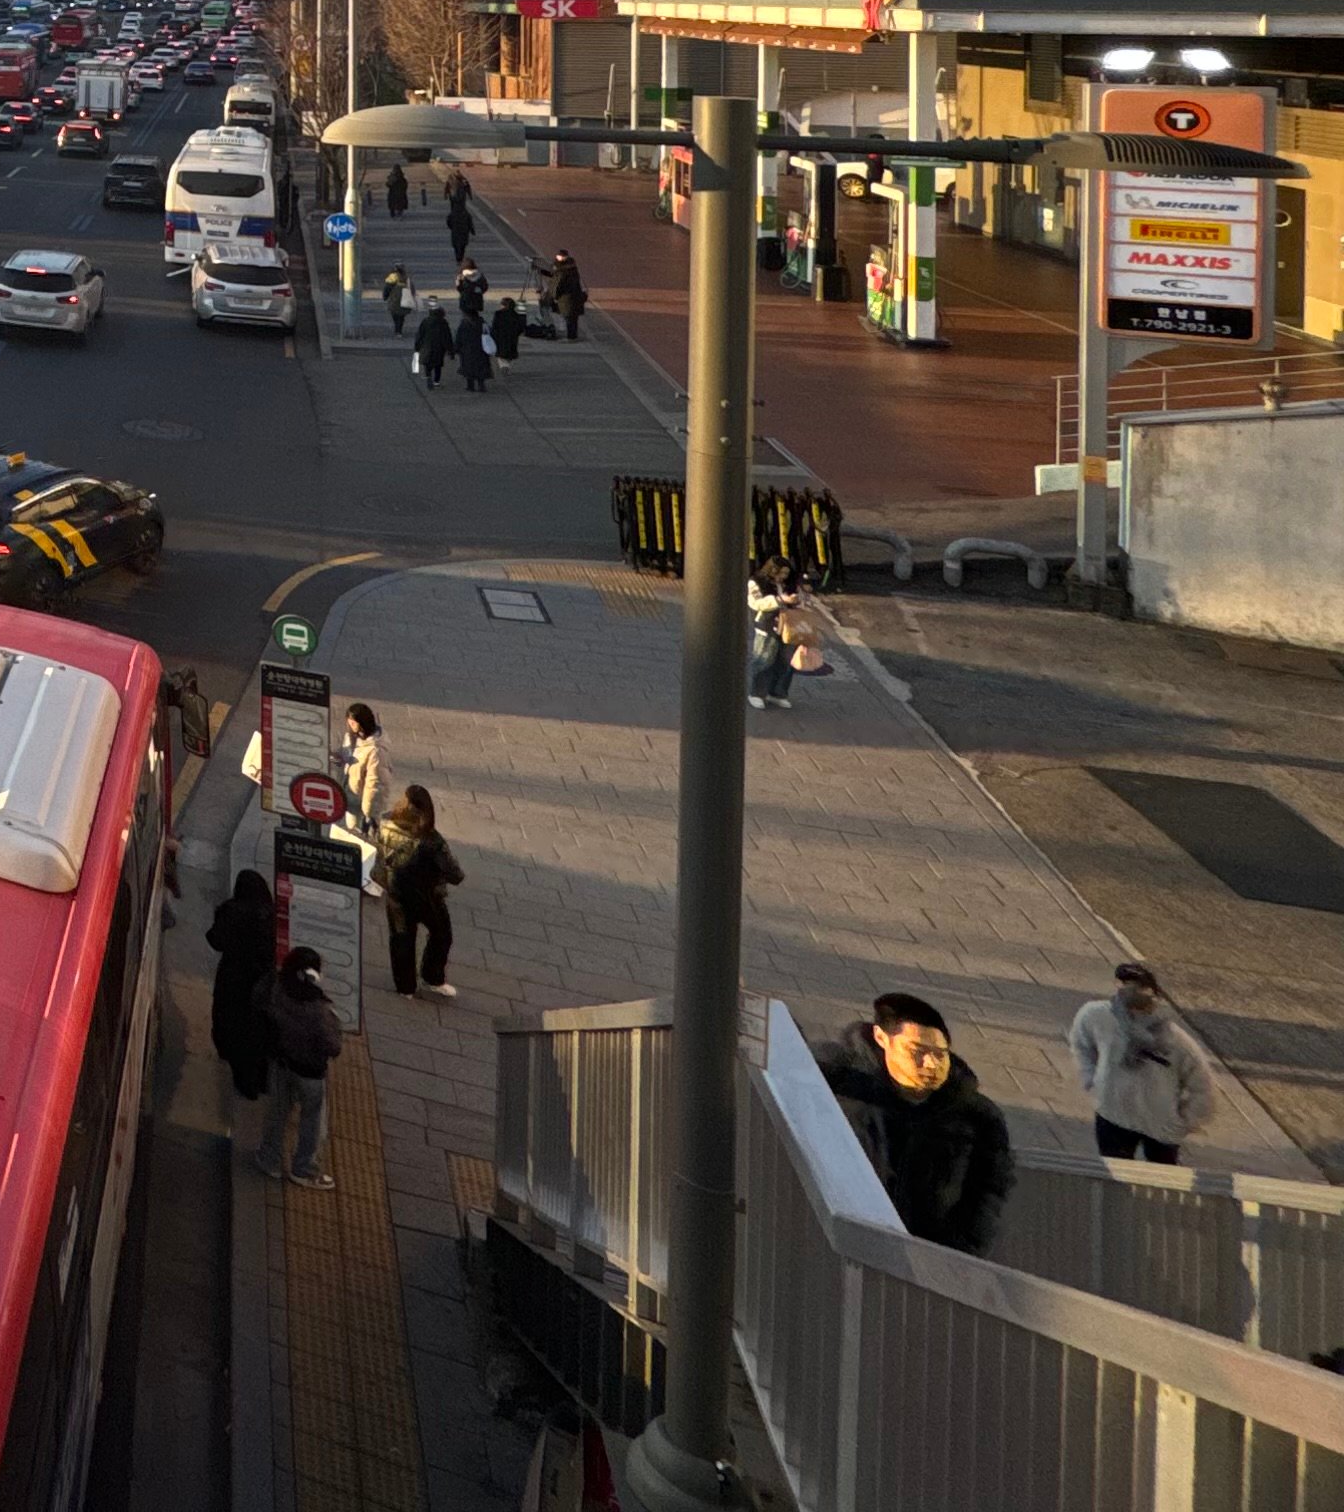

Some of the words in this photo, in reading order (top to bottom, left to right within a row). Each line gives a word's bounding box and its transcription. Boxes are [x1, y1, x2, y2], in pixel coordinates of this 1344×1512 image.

[541, 0, 577, 18] SK
[1169, 112, 1196, 130] T
[1155, 200, 1240, 213] MICHELIN
[205, 219, 233, 227] POLICE
[1139, 224, 1220, 241] PIRELLI
[1127, 251, 1233, 271] MAXXIS
